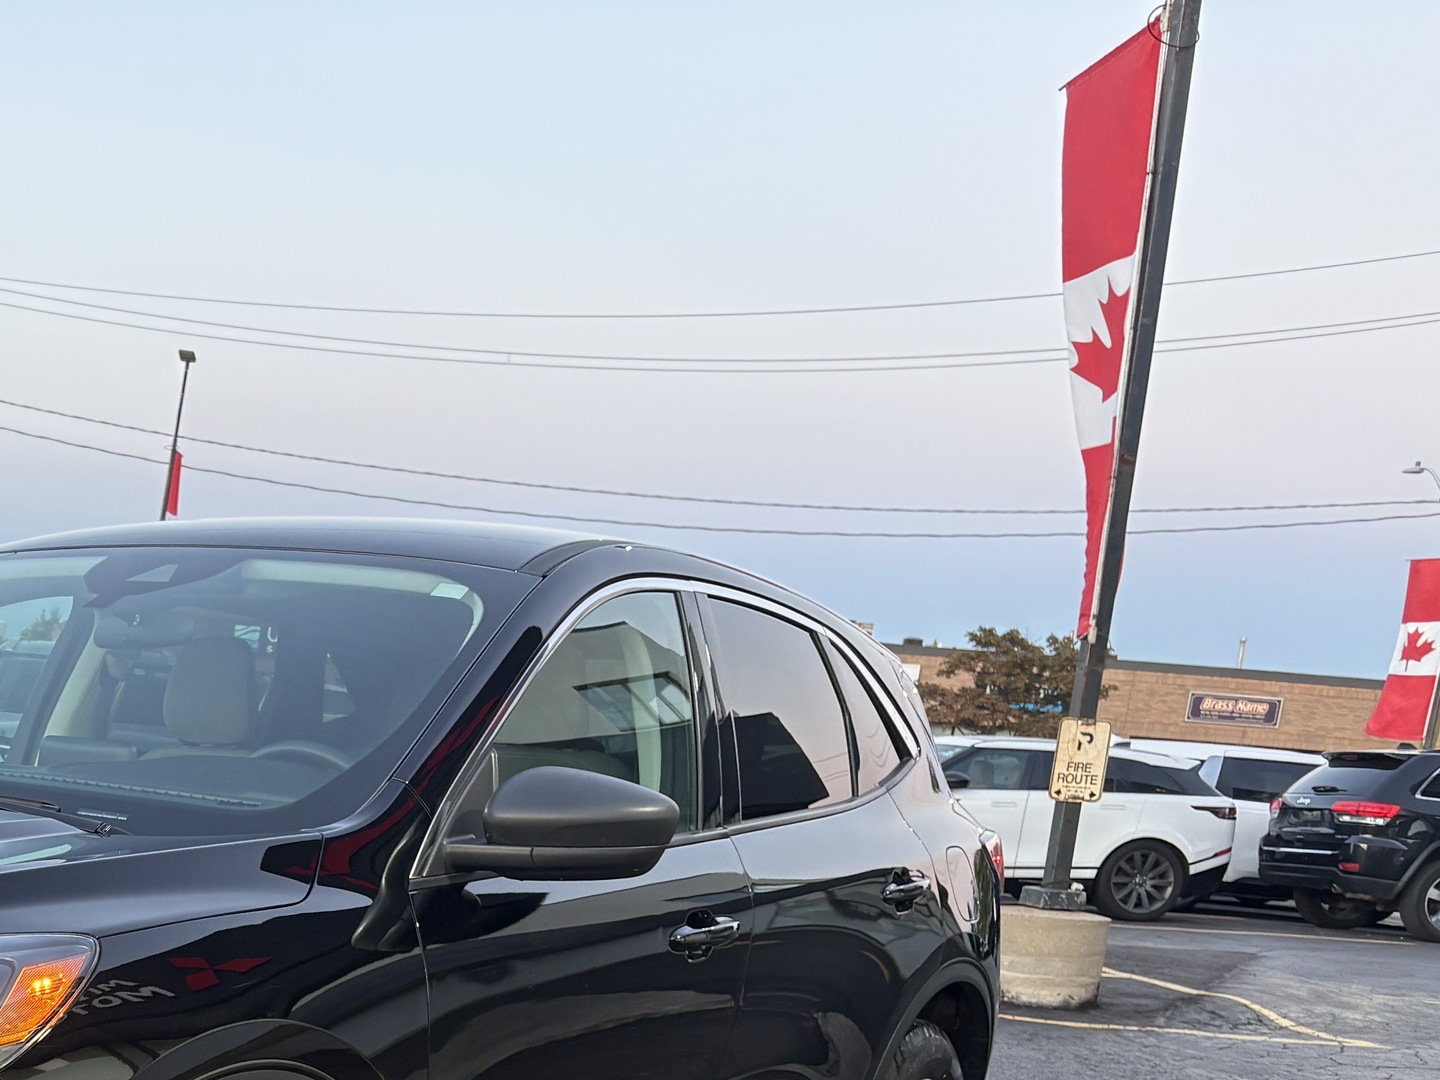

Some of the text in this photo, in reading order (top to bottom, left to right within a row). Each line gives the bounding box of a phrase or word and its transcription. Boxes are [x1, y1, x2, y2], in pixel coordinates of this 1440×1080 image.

[1201, 698, 1234, 711] Brass
[1235, 700, 1268, 714] Name
[1066, 761, 1092, 773] FIRE
[1057, 772, 1098, 785] ROUTE
